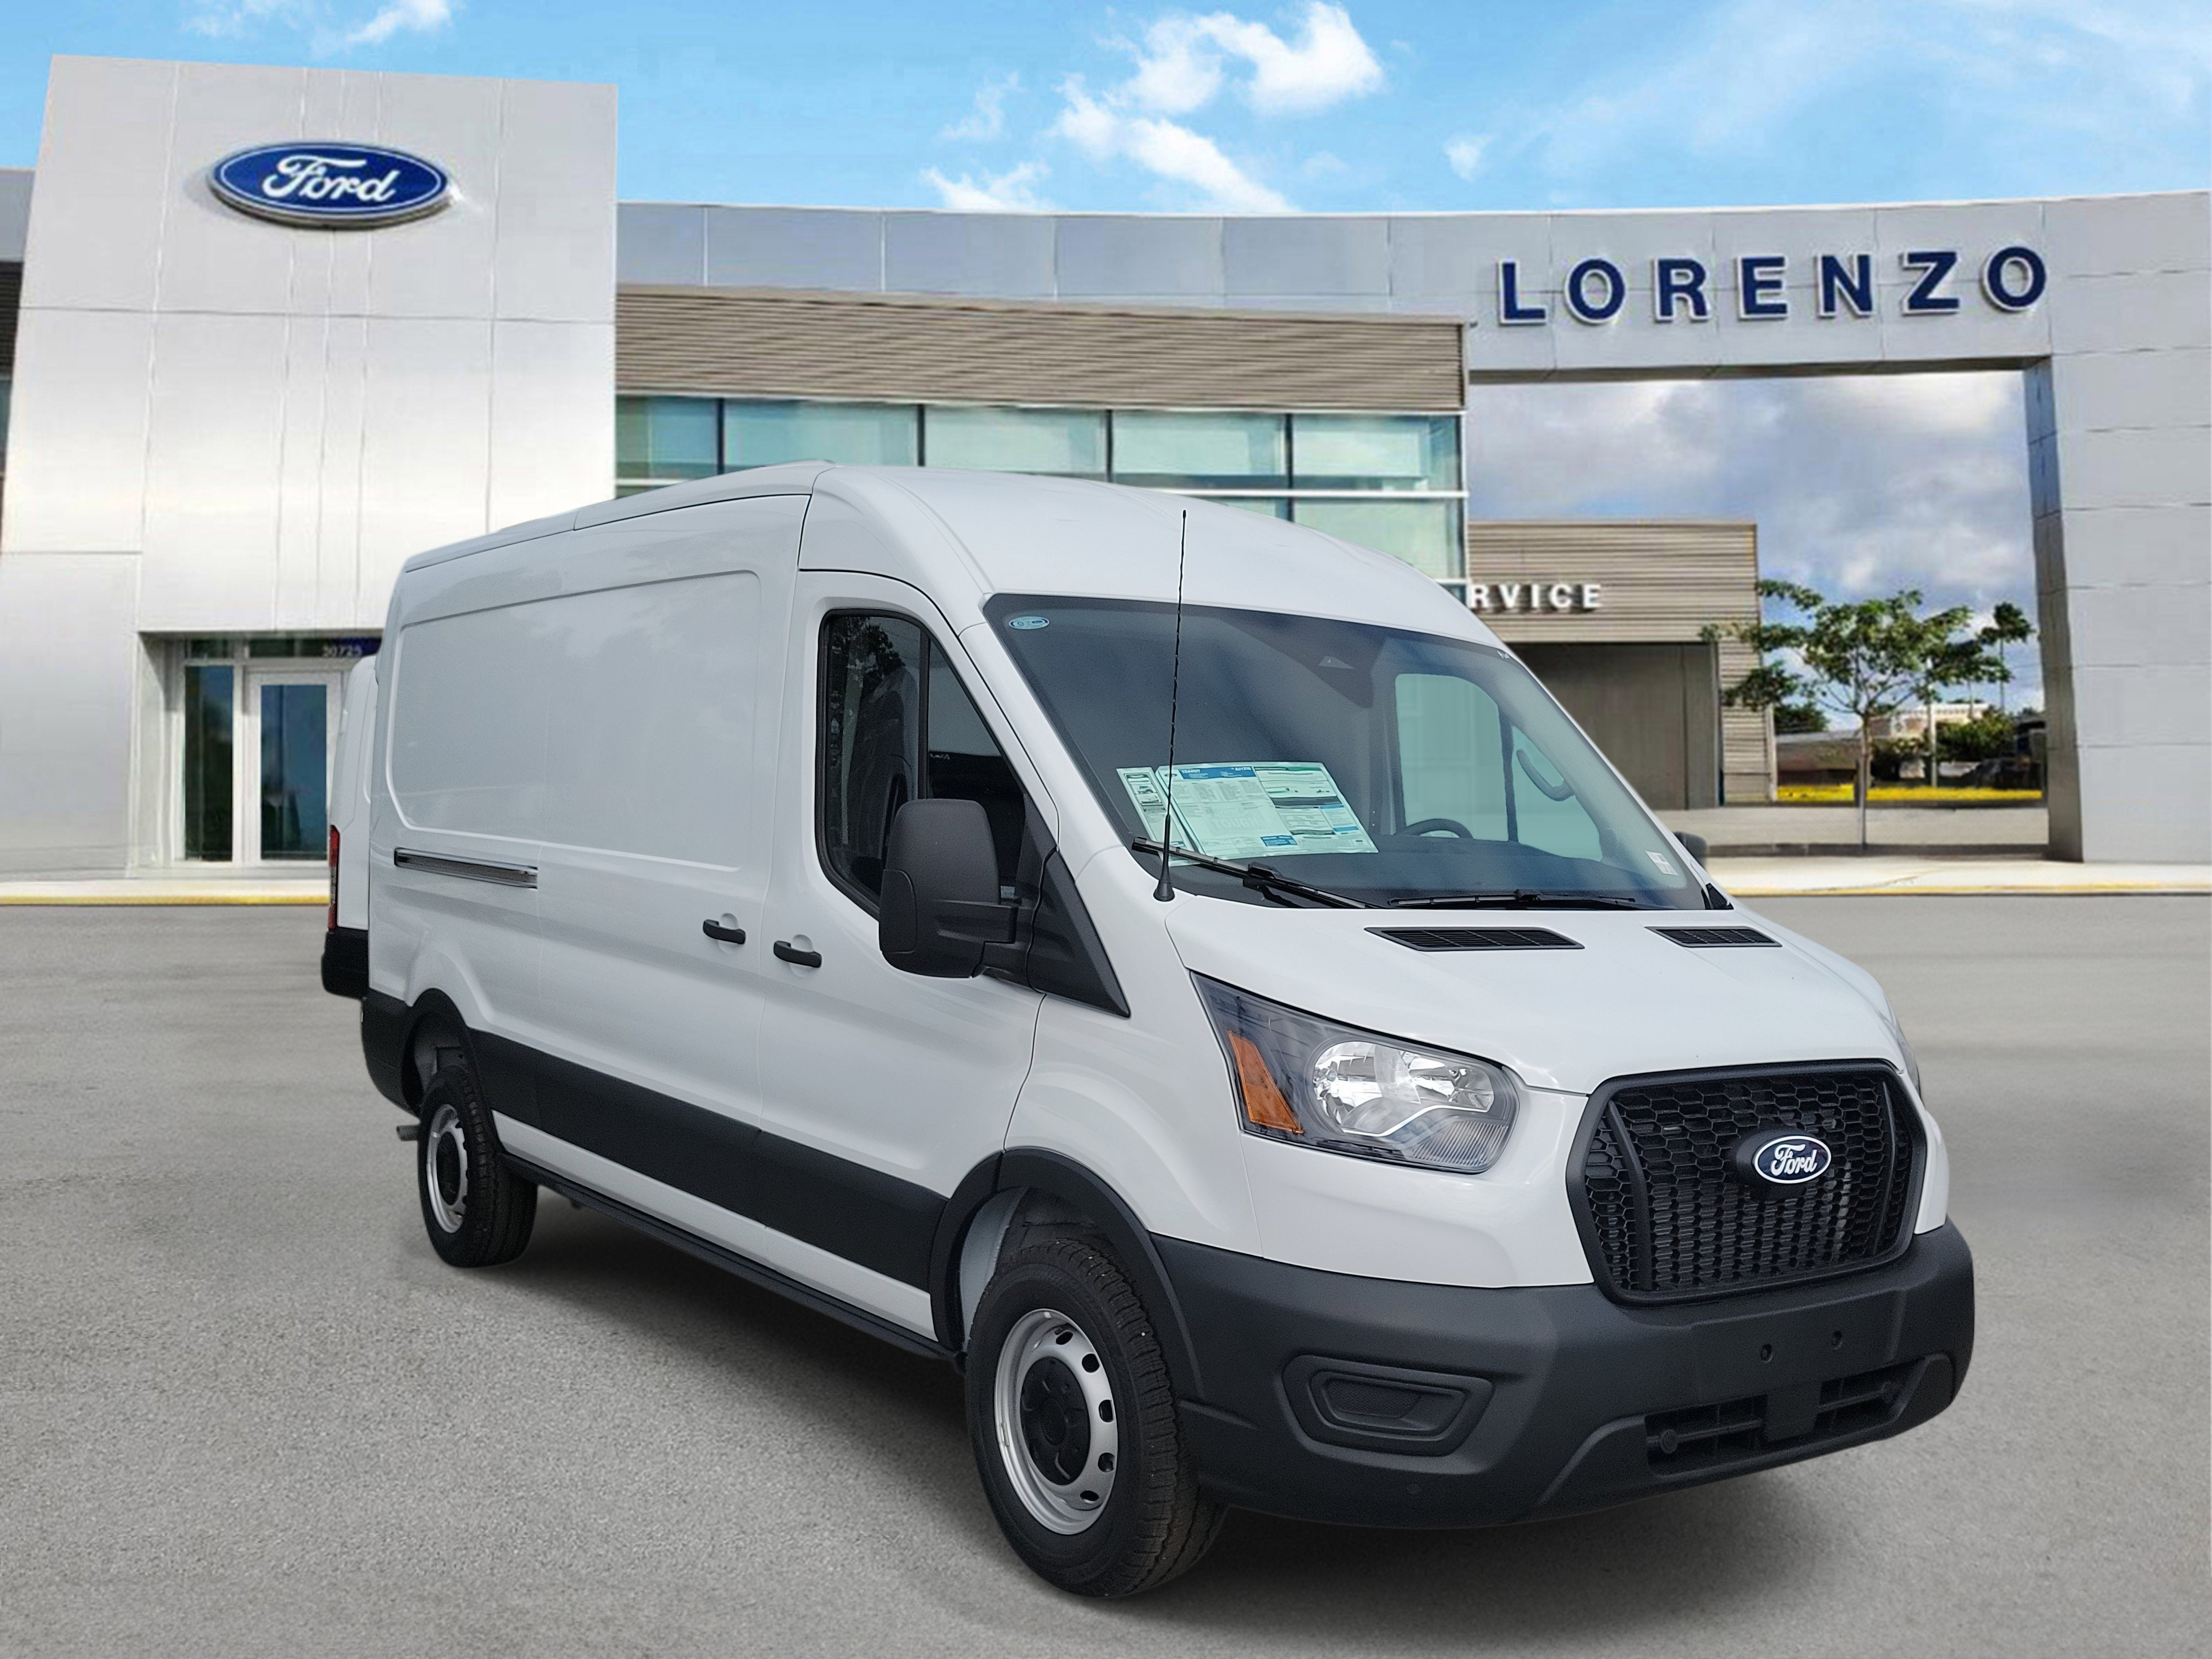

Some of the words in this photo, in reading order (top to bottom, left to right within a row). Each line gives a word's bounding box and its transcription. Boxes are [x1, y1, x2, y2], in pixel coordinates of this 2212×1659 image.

[262, 155, 400, 201] Ford
[1499, 246, 2048, 325] LORENZO
[1470, 584, 1602, 608] RVICE
[1771, 1144, 1819, 1176] Ford
